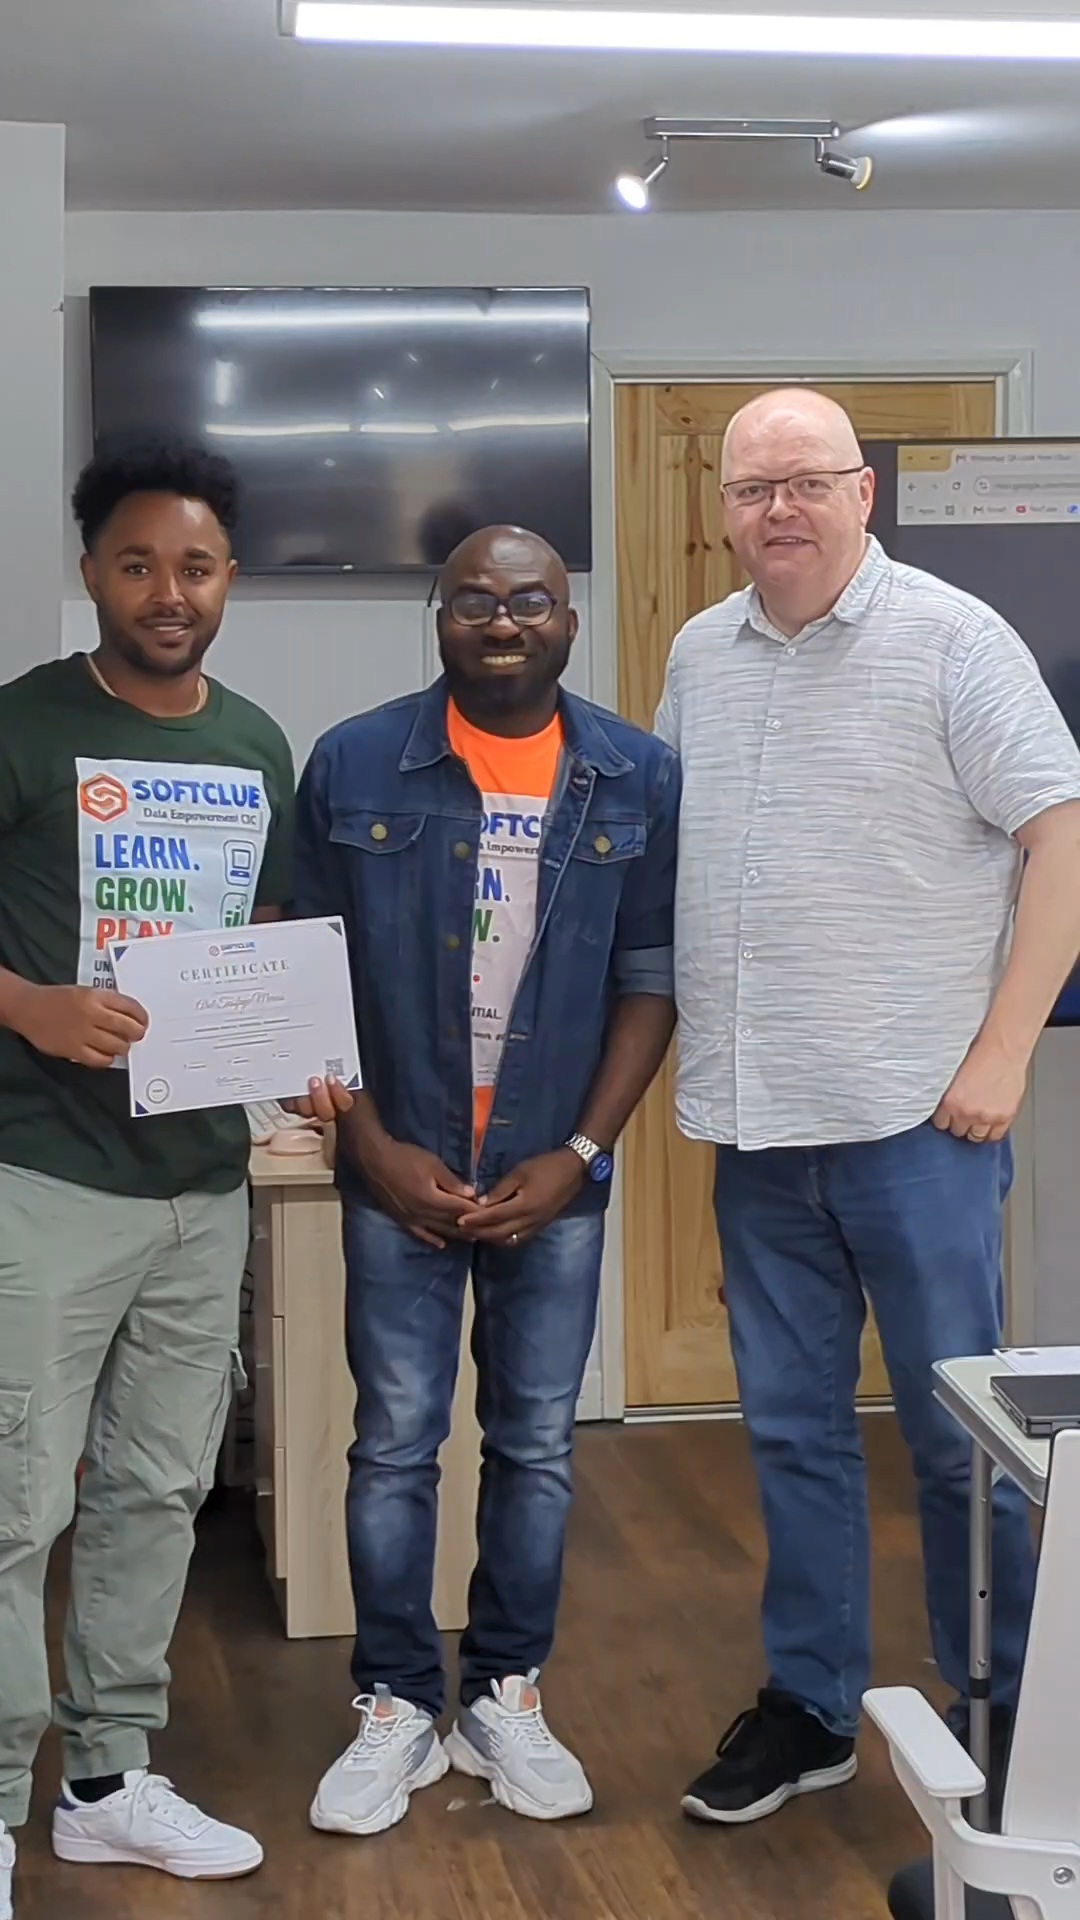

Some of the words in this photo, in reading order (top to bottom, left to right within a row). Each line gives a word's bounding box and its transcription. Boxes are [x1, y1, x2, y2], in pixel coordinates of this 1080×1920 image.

[132, 779, 260, 809] SOFTCLUE
[143, 807, 168, 819] Data
[170, 808, 239, 823] Empowerment
[95, 833, 201, 871] LEARN.
[95, 876, 194, 913] GROW.
[94, 959, 115, 973] UN
[180, 959, 290, 981] CERTIFICATE
